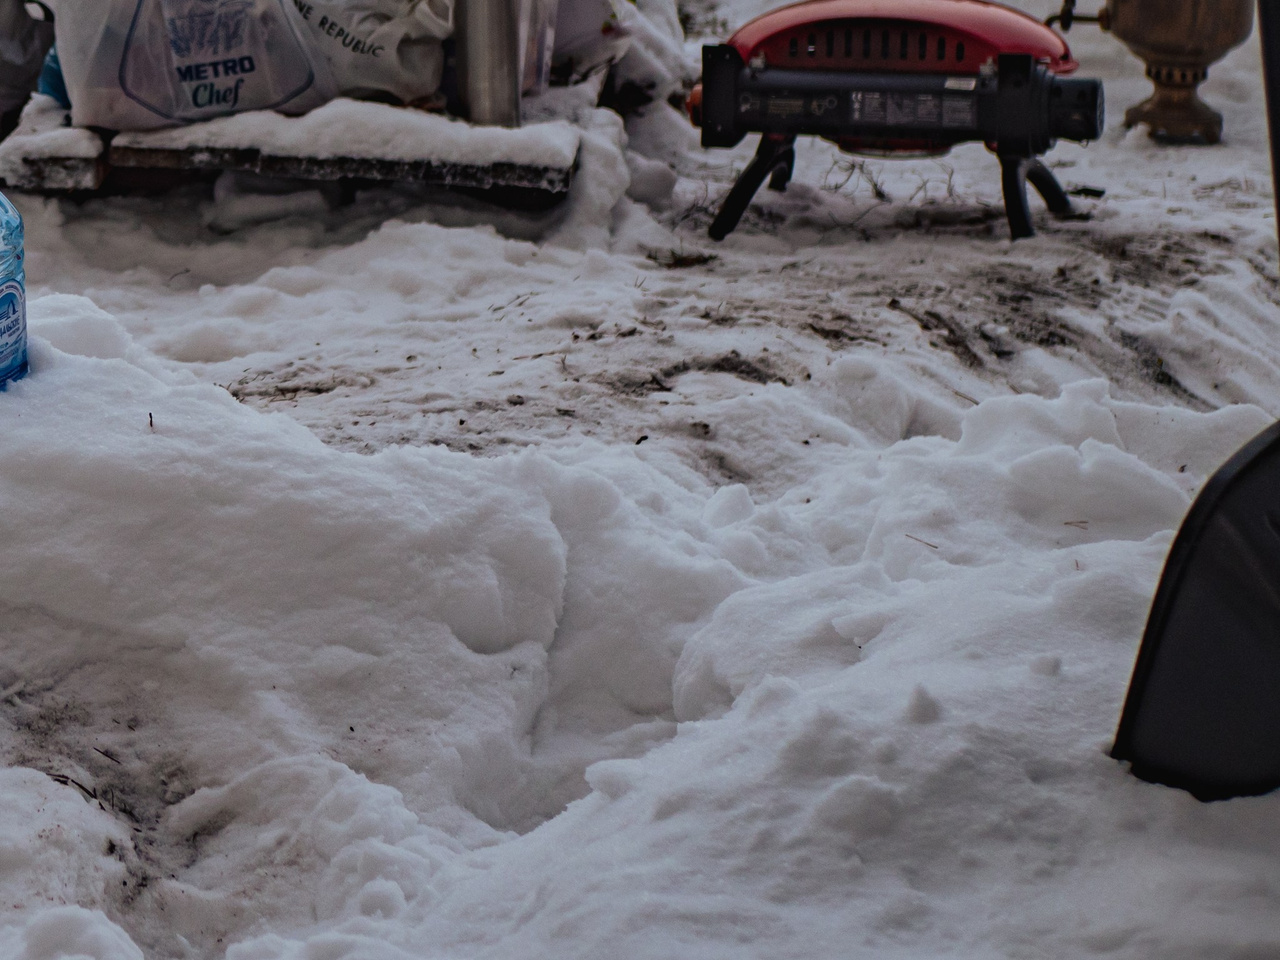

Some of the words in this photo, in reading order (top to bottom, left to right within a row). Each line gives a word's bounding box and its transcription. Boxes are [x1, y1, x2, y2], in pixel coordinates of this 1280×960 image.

[318, 14, 386, 58] REPUBLIC
[176, 55, 256, 83] METRO
[191, 78, 244, 109] Chef
